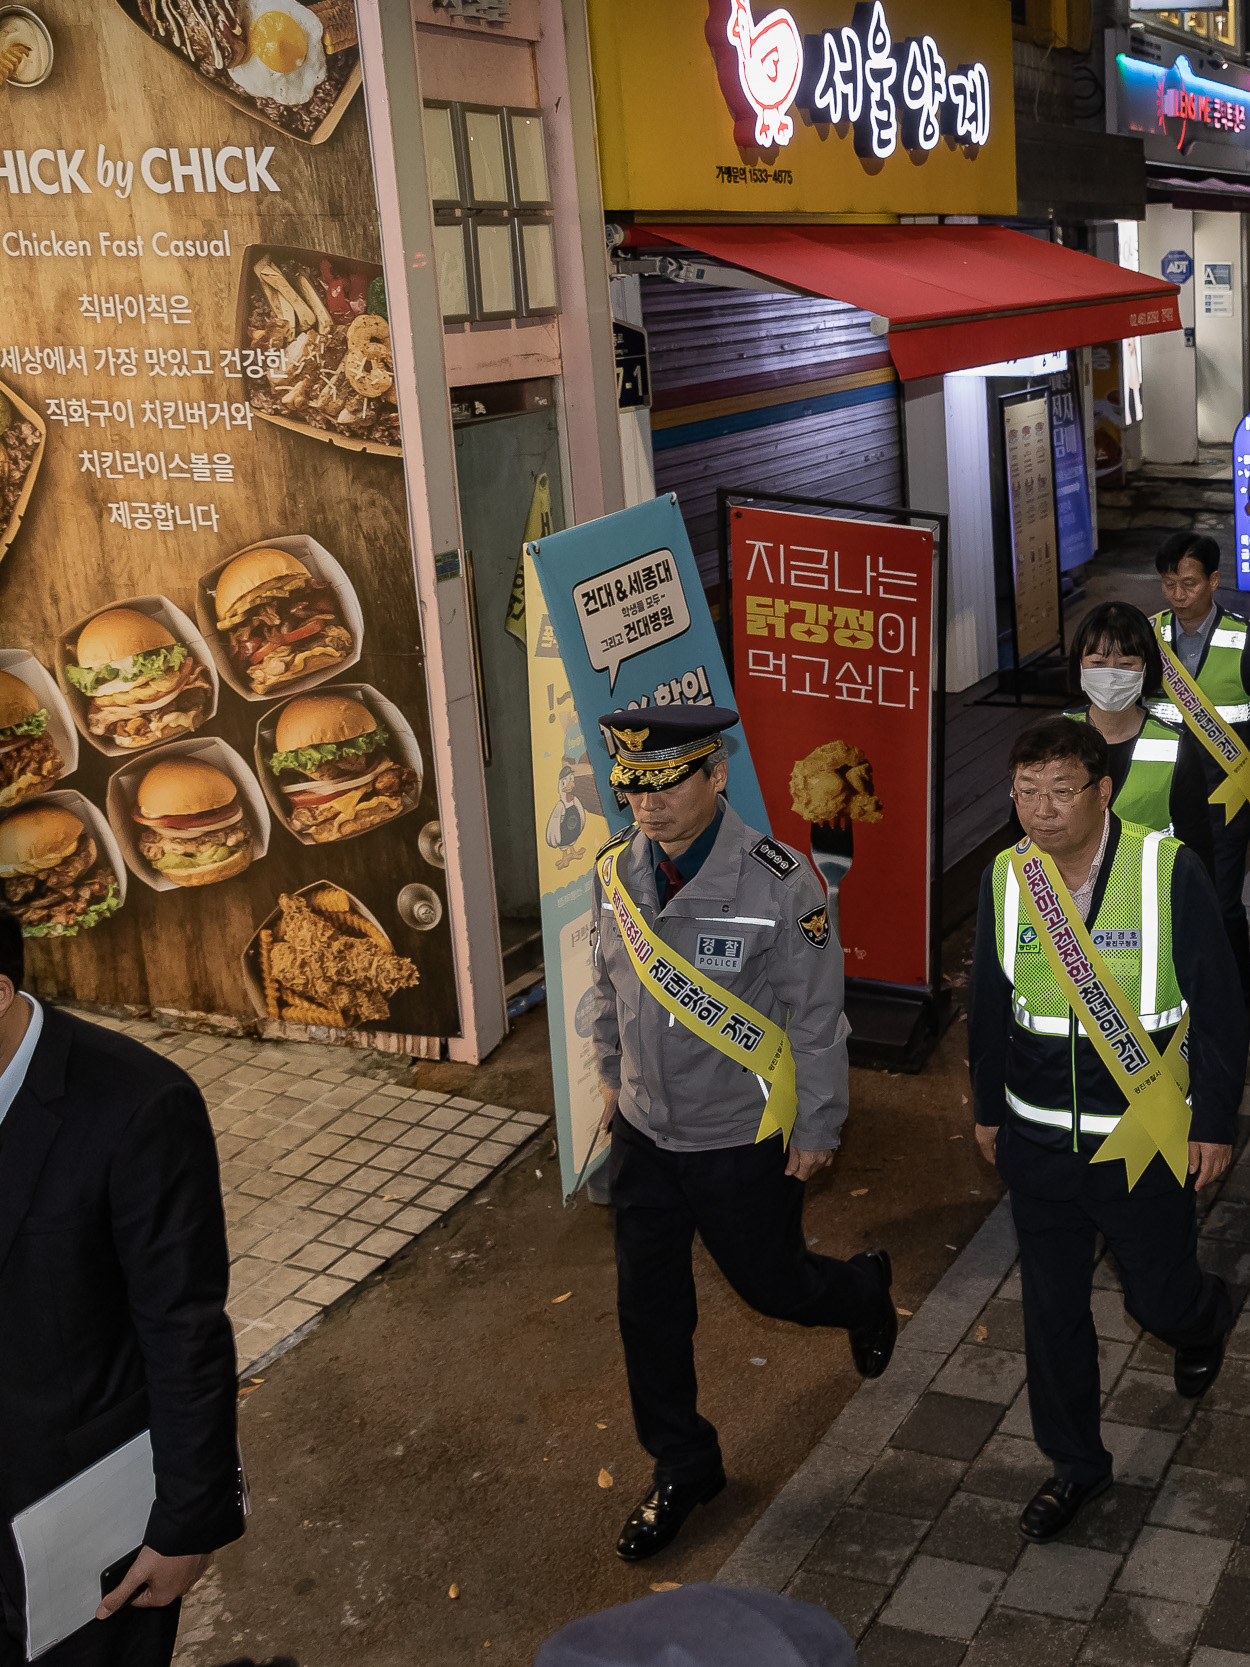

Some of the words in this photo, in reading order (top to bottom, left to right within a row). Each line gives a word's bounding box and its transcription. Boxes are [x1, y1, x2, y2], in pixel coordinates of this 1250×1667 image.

[97, 144, 133, 199] by
[141, 146, 281, 194] CHICK
[716, 165, 747, 184] 가맹문의
[2, 230, 92, 257] Chicken
[99, 232, 145, 257] Fast
[152, 230, 231, 257] Casual
[1166, 261, 1189, 274] ADT
[78, 293, 192, 325] 칙바이칙은
[0, 348, 89, 379] 세상에서
[93, 348, 138, 378] 가장
[144, 349, 213, 379] 맛있고
[219, 349, 289, 380] 건강한
[46, 399, 134, 428] 직화구이
[141, 400, 254, 431] 치킨버거와
[78, 450, 235, 483] 치킨라이스볼을
[108, 502, 220, 533] 제공합니다
[745, 540, 918, 602] 지금나는
[600, 634, 624, 654] 그리고
[624, 606, 675, 645] 건대병원
[745, 595, 917, 657] 닭강정이
[748, 649, 920, 710] 먹고싶다
[1170, 676, 1201, 713] 건전한
[1192, 707, 1226, 745] 청년의
[1216, 736, 1242, 763] 거리
[699, 957, 738, 968] POLICE
[702, 938, 740, 958] 경찰
[611, 886, 654, 965] 범죄없는
[647, 955, 729, 1028] 건대맛의
[717, 1013, 766, 1053] 거리
[1021, 856, 1069, 934] 안전하고
[1051, 926, 1095, 987] 건전한
[1078, 980, 1129, 1041] 청년의
[1110, 1031, 1151, 1076] 거리
[1133, 1070, 1162, 1095] 광진경찰서
